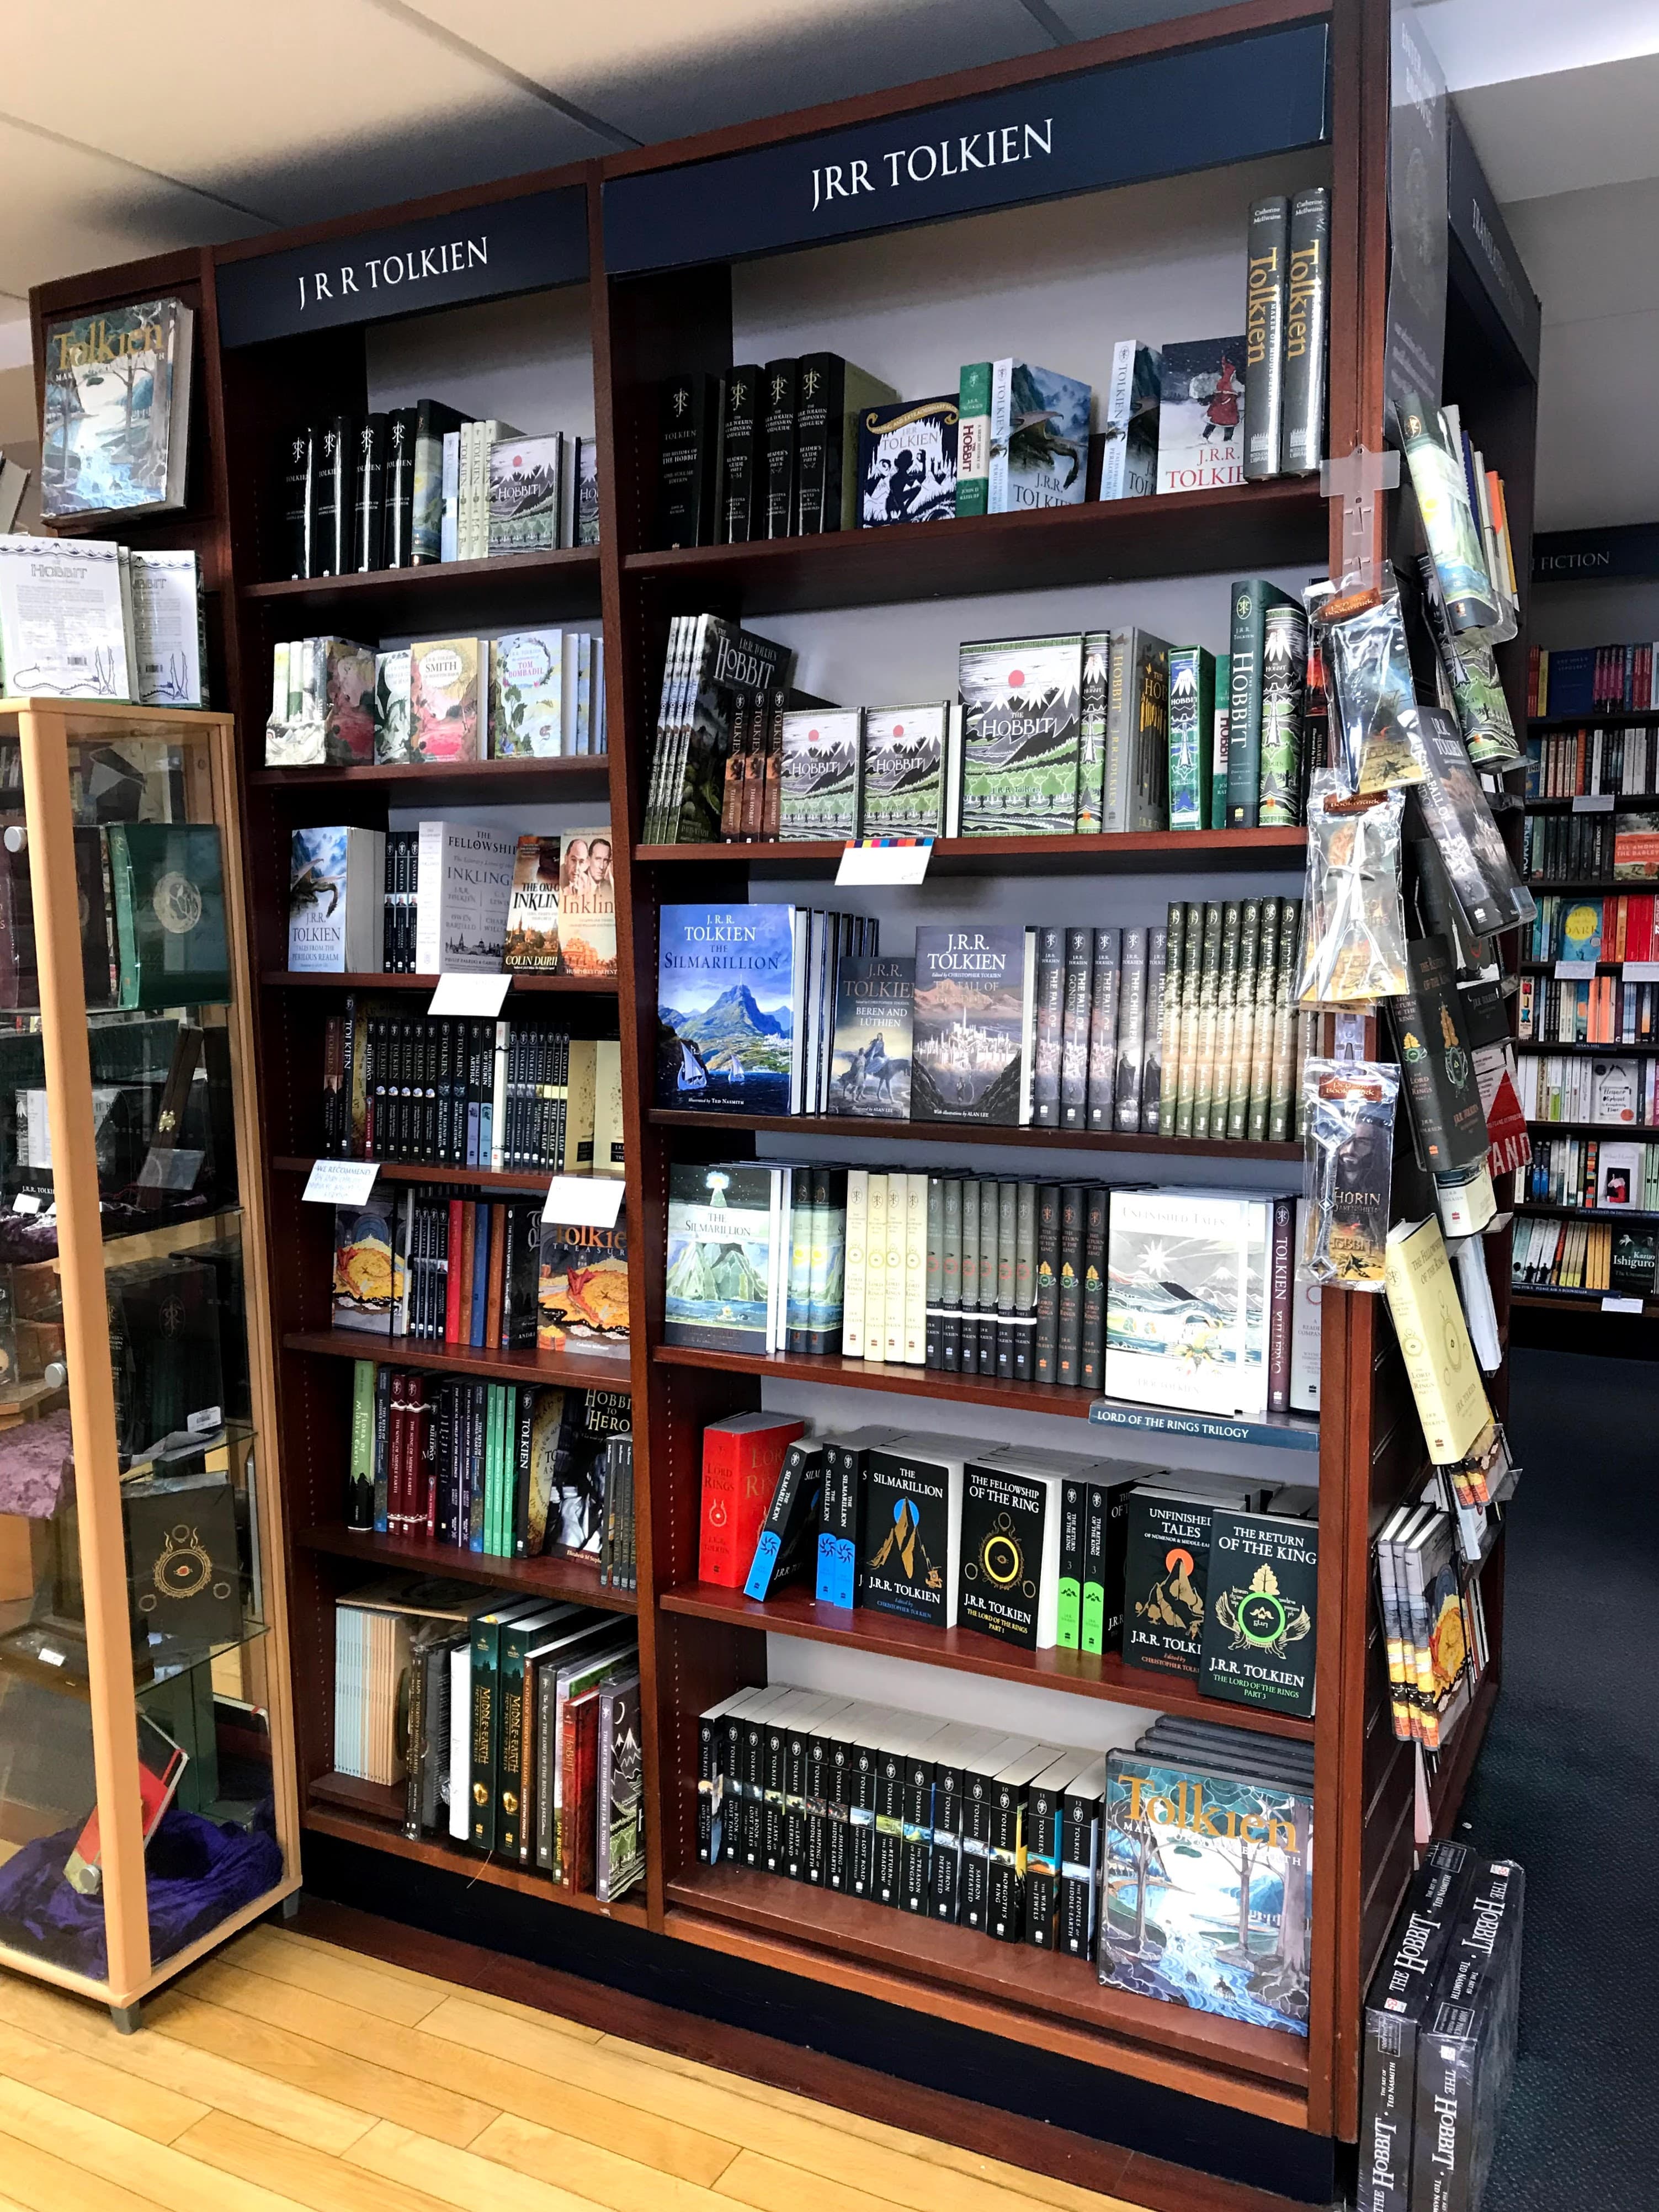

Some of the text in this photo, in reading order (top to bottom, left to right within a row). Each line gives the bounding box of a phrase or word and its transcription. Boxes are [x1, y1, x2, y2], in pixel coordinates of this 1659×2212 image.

[811, 119, 1055, 212] JRR TOLKIEN
[1254, 205, 1280, 217] Catherine
[1296, 198, 1323, 209] Catherine
[295, 236, 488, 310] J R R TOLKIEN
[1248, 247, 1277, 366] Tolkien
[1288, 240, 1319, 360] Tolkien
[54, 321, 162, 370] Tolkien
[1116, 364, 1127, 422] TOLKIEN
[996, 385, 1006, 440] TOLKIEN
[665, 430, 696, 440] TOLKIEN
[882, 431, 938, 451] TOLKIEN
[963, 424, 974, 472] HOBBIT
[1197, 447, 1240, 465] J.R.R.
[460, 441, 468, 486] TOLKIEN
[498, 483, 538, 499] HOBBIT
[1035, 473, 1063, 493] J.R.R.
[1541, 551, 1610, 570] FICTION
[425, 661, 457, 672] SMITH
[518, 661, 533, 669] TOM
[714, 635, 774, 689] HOBBIT
[1265, 664, 1286, 672] HOBBIT
[1112, 656, 1123, 712] HOBBIT
[1171, 696, 1198, 705] HOBBIT
[1231, 651, 1254, 748] HOBBIT
[732, 710, 742, 757] TOLKIEN
[752, 708, 762, 757] TOLKIEN
[773, 708, 783, 757] TOLKIEN
[982, 717, 1054, 738] HOBBIT
[792, 761, 838, 775] HOBBIT
[876, 758, 923, 772] HOBBIT
[476, 831, 491, 839] THE
[306, 912, 326, 924] J.R.R.
[707, 914, 735, 924] J. R. R.
[293, 927, 340, 942] TOLKIEN
[684, 927, 756, 942] TOLKIEN
[947, 934, 990, 951] J.R.R.
[318, 953, 339, 961] REALM
[710, 944, 728, 953] THE
[506, 956, 532, 966] COLIN
[664, 952, 779, 970] SILMARILLION
[869, 963, 902, 977] J.R.R.
[928, 953, 1006, 971] TOLKIEN
[856, 1007, 907, 1017] BEREN AND
[1129, 988, 1139, 1044] CHILDREN
[860, 1017, 901, 1028] LÚTHIEN
[344, 1019, 353, 1070] TOLKIEN
[1489, 1132, 1533, 1174] AND
[316, 1165, 329, 1173] WE
[685, 1220, 751, 1236] SILMARILLION
[708, 1213, 726, 1223] THE
[1612, 1255, 1655, 1268] Ishiguro
[1633, 1250, 1655, 1259] Kazuo
[1275, 1237, 1288, 1301] TOLKIEN
[1098, 1411, 1249, 1439] LORD OF THE RINGS TRILOGY
[520, 1418, 530, 1470] TOLKIEN
[900, 1468, 916, 1480] THE
[873, 1472, 943, 1498] SILMARILLION
[971, 1475, 1040, 1498] THE FELLOWSHIP
[969, 1486, 1040, 1514] OF THE RING
[1162, 1522, 1201, 1538] TALES
[1233, 1527, 1304, 1547] THE RETURN
[1219, 1536, 1317, 1565] OF THE KING
[869, 1576, 941, 1605] J.R.R. TOLKIEN
[964, 1594, 1031, 1625] J.R.R. TOLKIEN
[967, 1608, 978, 1617] THE
[979, 1612, 993, 1621] LORD
[1001, 1619, 1012, 1629] THE
[1012, 1623, 1028, 1634] RINGS
[988, 1623, 1001, 1633] PART
[1131, 1630, 1160, 1647] J.R.R.
[1210, 1658, 1304, 1688] J.R.R. TOLKIEN
[1214, 1674, 1229, 1683] THE
[1230, 1677, 1249, 1687] LORD
[1261, 1683, 1275, 1694] THE
[1277, 1687, 1299, 1698] RINGS
[1244, 1689, 1260, 1699] PART
[564, 1733, 575, 1774] HOBBIT
[1118, 1775, 1299, 1853] Tolkien
[1490, 1881, 1508, 1900] THE
[1462, 1896, 1506, 1957] HOBBIT
[1394, 1911, 1440, 1974] HOBBIT
[1388, 1970, 1410, 1992] THE
[1445, 2070, 1456, 2093] THE
[1432, 2094, 1457, 2171] HOBBIT
[1374, 2117, 1397, 2190] HOBBIT
